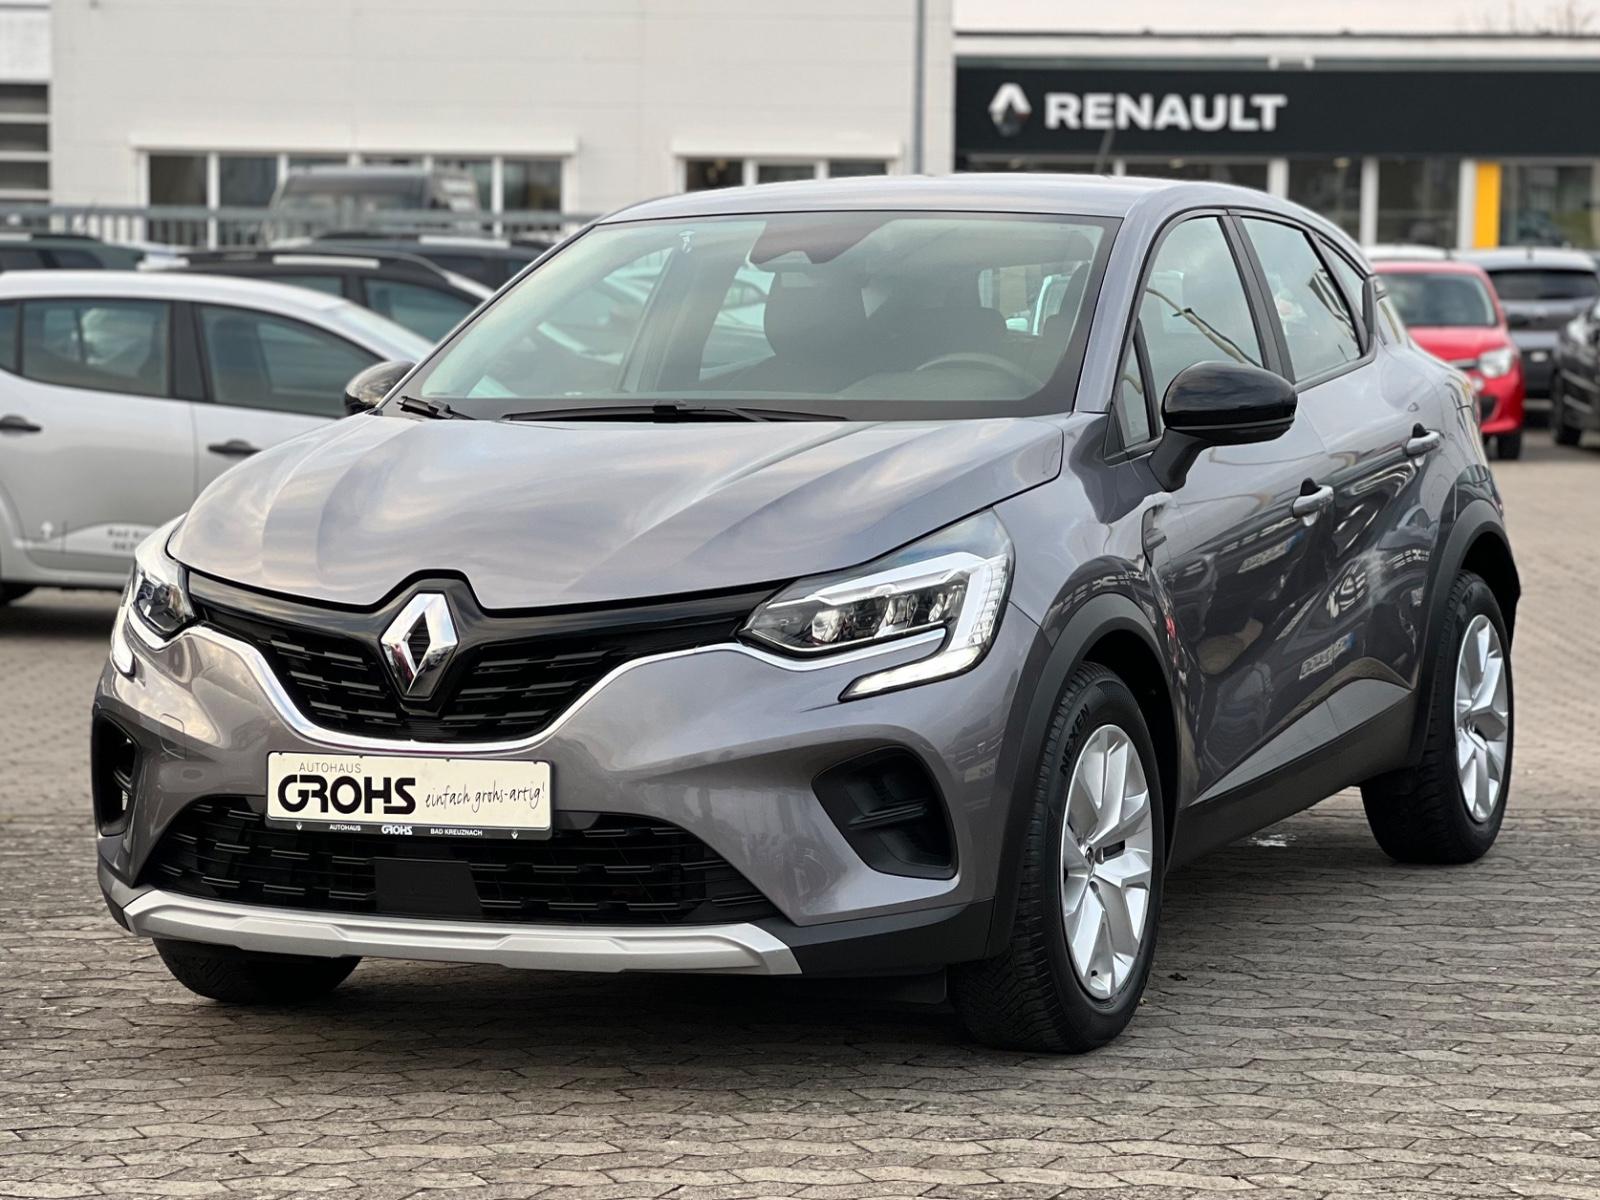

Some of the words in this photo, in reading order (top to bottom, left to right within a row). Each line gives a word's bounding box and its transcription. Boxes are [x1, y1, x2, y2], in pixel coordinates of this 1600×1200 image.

[1044, 93, 1288, 131] RENAULT
[1059, 703, 1090, 777] NEXEN
[299, 762, 361, 774] AUTOHAUS
[277, 774, 416, 815] GROHS
[425, 784, 470, 808] einfach
[329, 823, 361, 832] AUTOHAUS
[381, 825, 413, 835] GROHS
[430, 828, 444, 836] BAD
[445, 828, 483, 837] KREUZNACH
